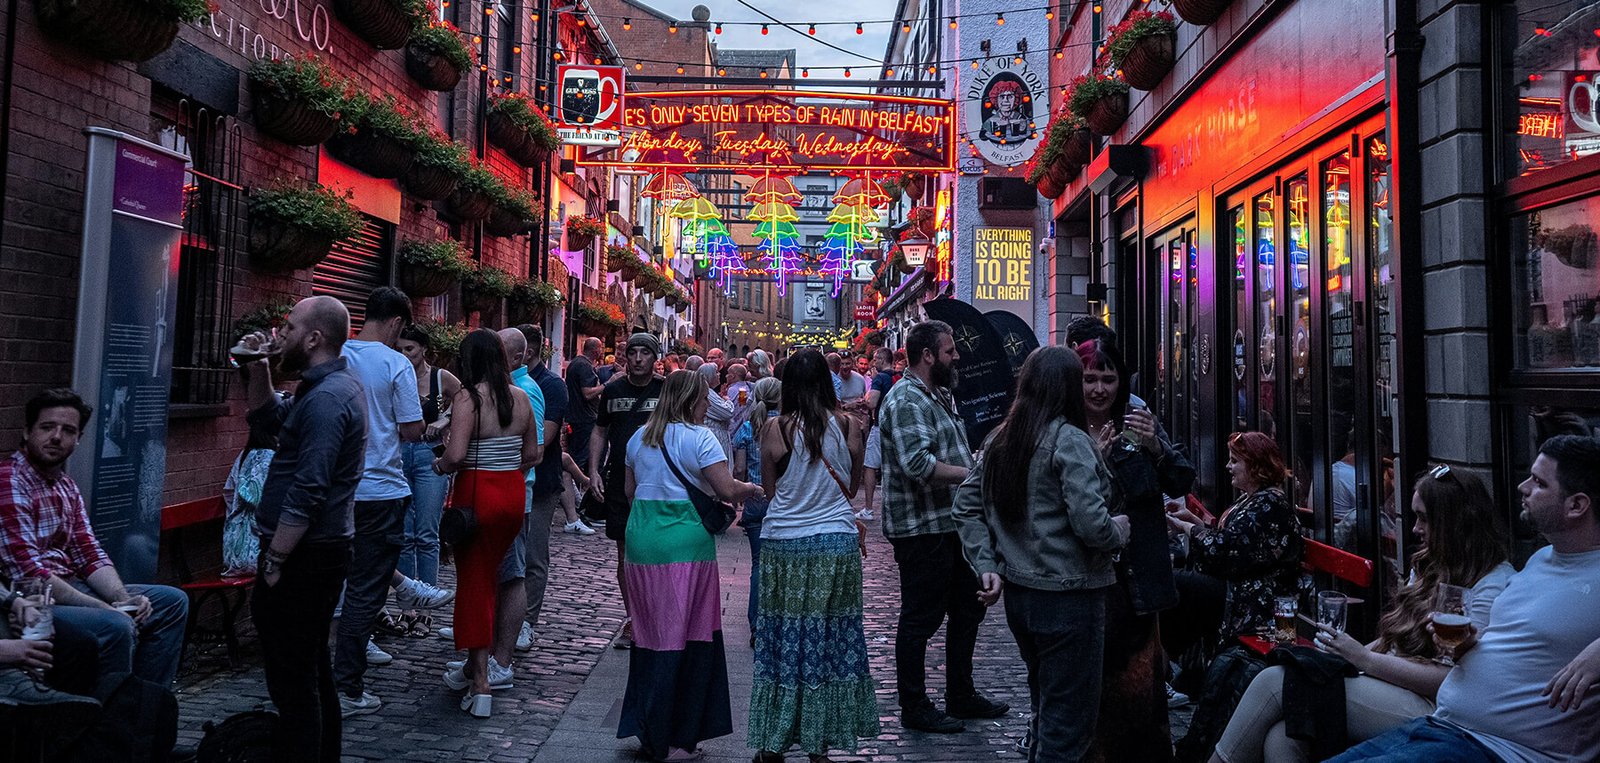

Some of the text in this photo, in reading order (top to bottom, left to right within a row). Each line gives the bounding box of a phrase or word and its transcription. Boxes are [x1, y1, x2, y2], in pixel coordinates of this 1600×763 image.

[968, 57, 1046, 101] DUKE OF YORK
[651, 104, 686, 125] ONLY
[692, 104, 740, 123] SEVEN
[745, 104, 791, 123] TYPES
[796, 105, 816, 124] OF
[820, 107, 856, 127] RAIN
[860, 109, 875, 129] IN
[1172, 123, 1201, 177] DARK
[1208, 79, 1257, 141] HORSE
[991, 150, 1024, 163] BELFAST
[976, 228, 1031, 242] EVERYTHING
[976, 241, 1031, 259] IS GOING
[976, 259, 1031, 286] TO BE
[976, 285, 1031, 301] ALL RIGHT
